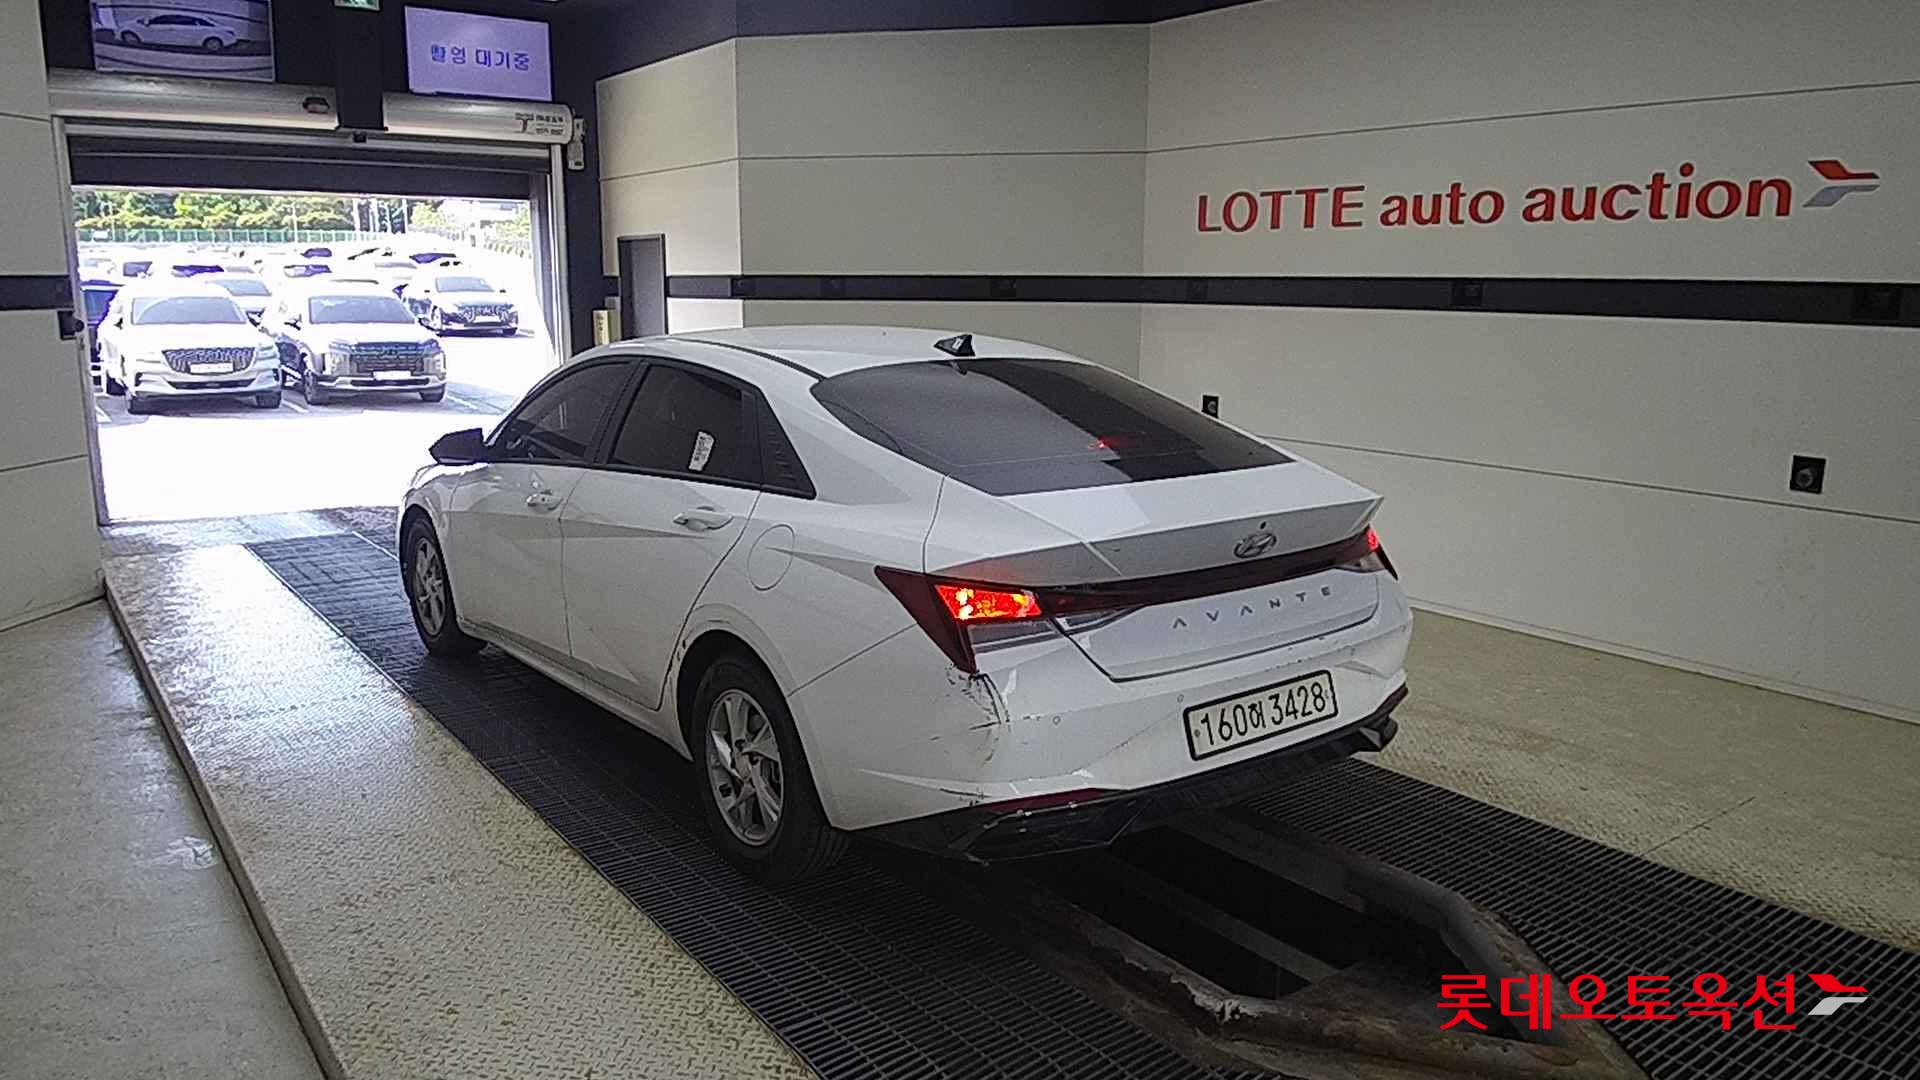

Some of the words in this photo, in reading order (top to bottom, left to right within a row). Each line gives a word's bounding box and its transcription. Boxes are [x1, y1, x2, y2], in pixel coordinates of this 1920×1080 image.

[474, 48, 530, 71] 대기중
[1198, 185, 1365, 232] LOTTE
[1380, 183, 1505, 226] auto
[1523, 162, 1793, 222] auction
[1172, 586, 1331, 629] AVANTE
